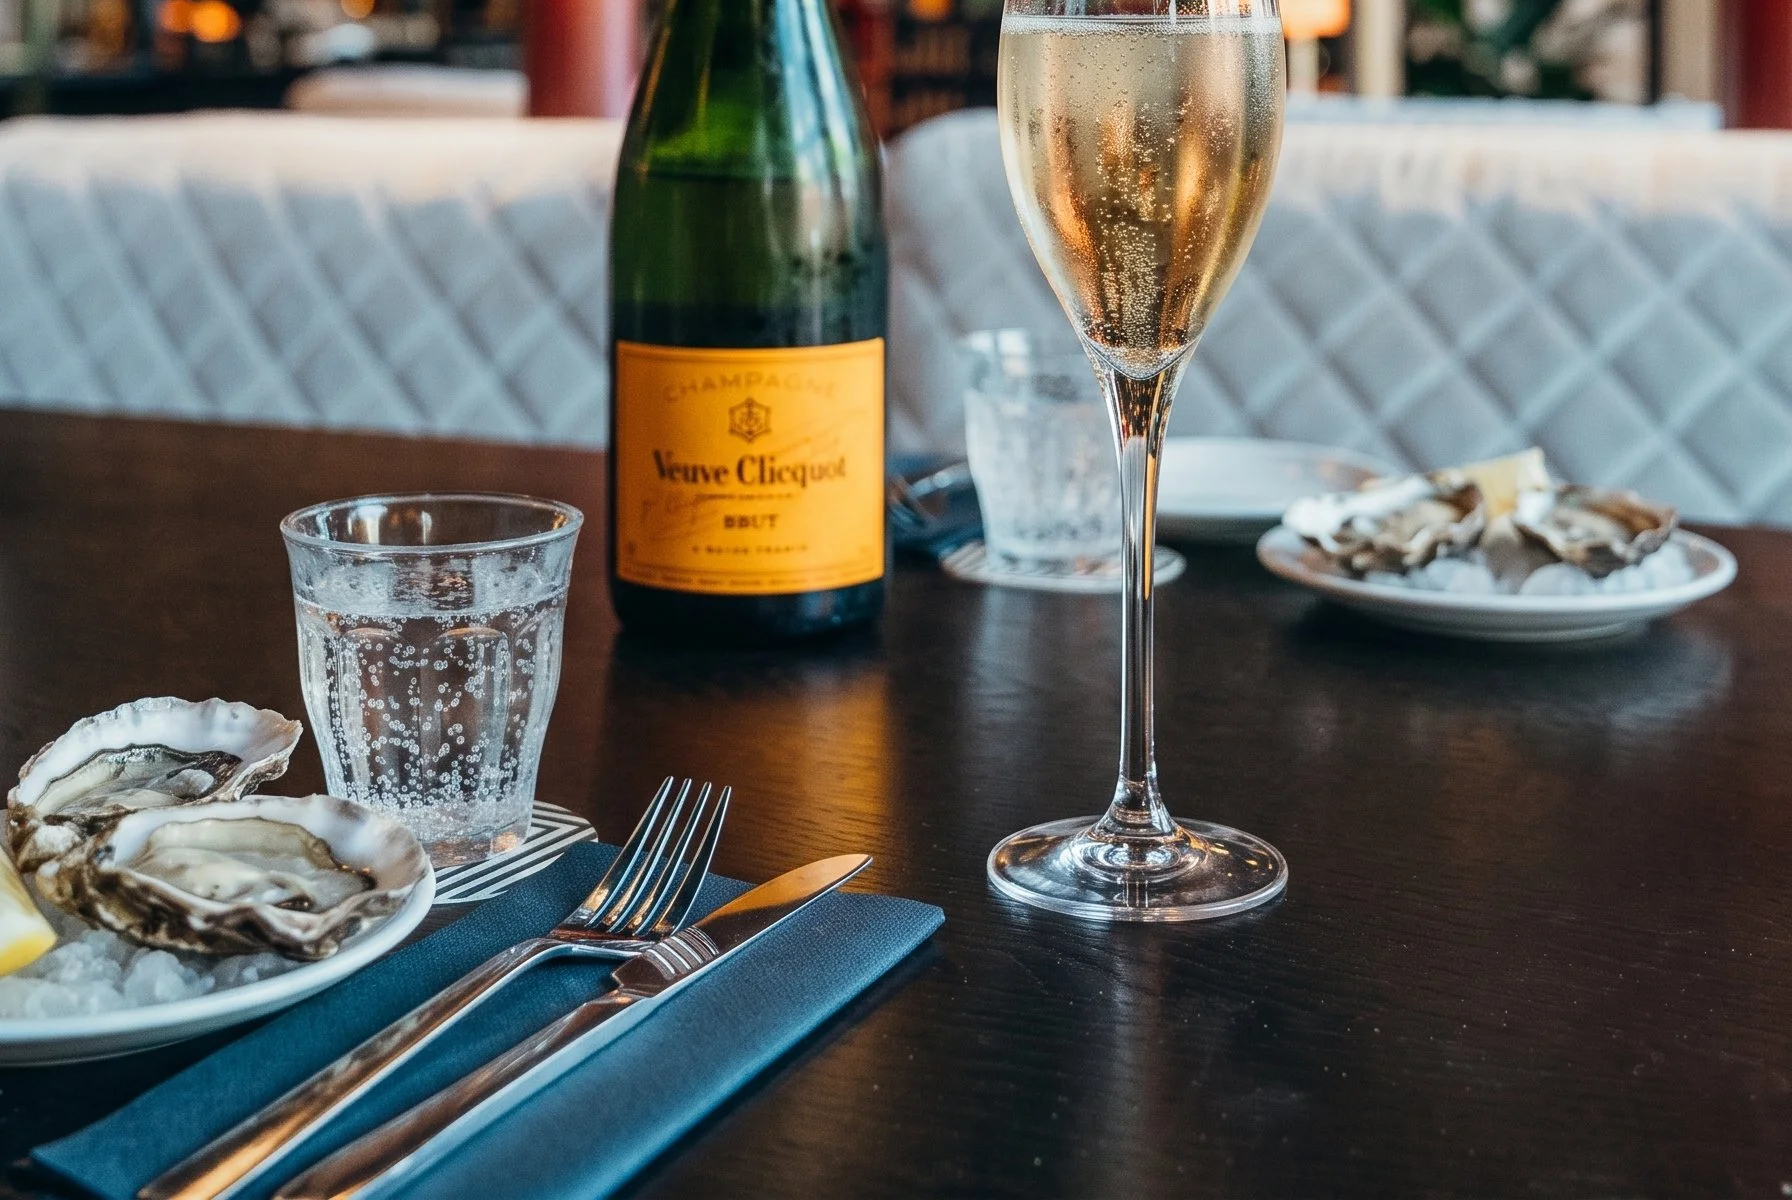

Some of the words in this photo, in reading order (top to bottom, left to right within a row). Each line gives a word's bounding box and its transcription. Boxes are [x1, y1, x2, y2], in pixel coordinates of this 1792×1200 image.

[663, 371, 837, 403] CHAMPAGNE
[652, 448, 729, 486] Veuve
[736, 454, 847, 489] Clicquot
[723, 513, 779, 530] BRUT
